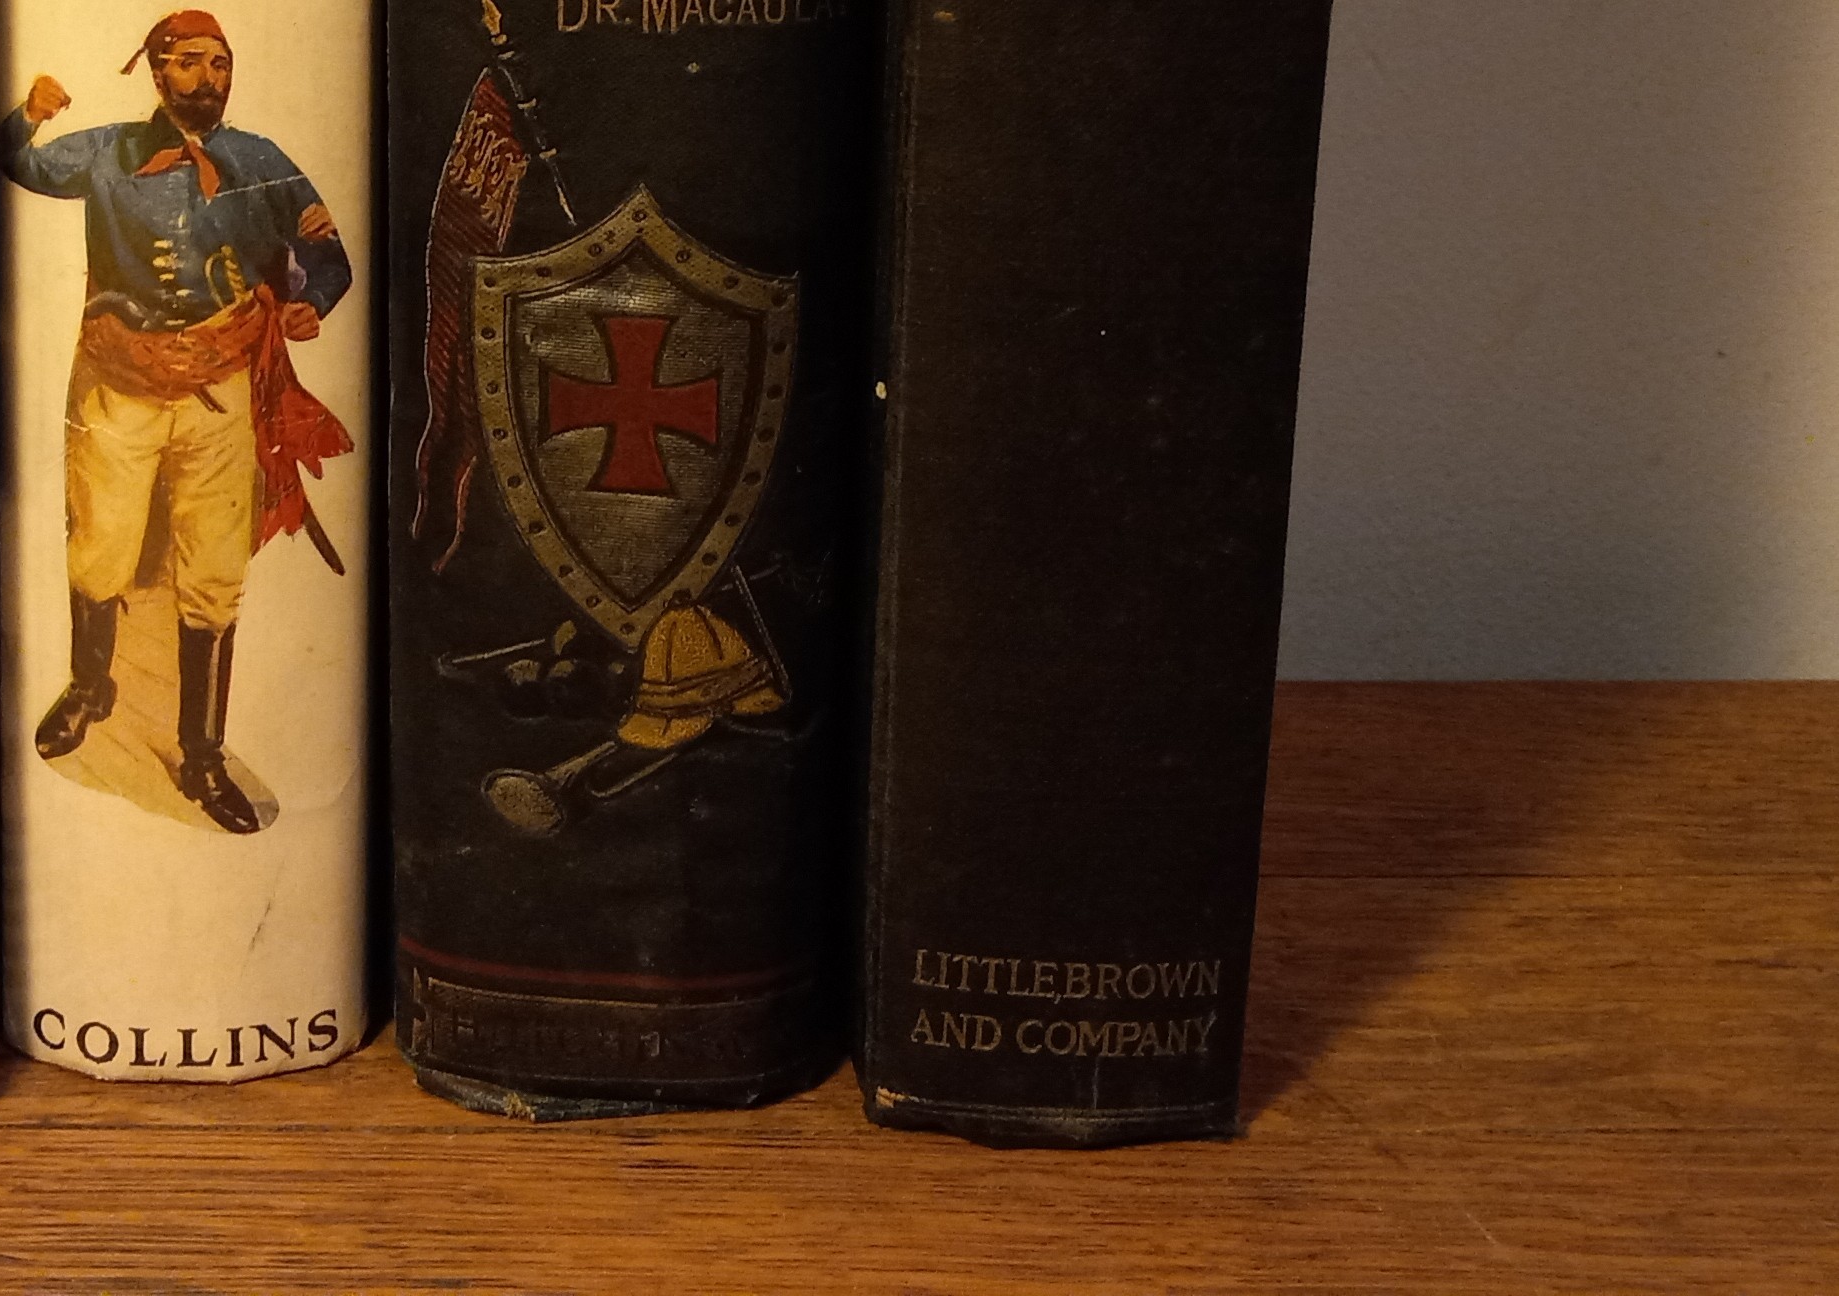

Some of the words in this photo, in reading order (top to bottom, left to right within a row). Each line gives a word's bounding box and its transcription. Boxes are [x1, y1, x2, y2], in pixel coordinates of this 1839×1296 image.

[33, 1007, 338, 1068] COLLINS
[910, 1008, 1002, 1051] AND
[1015, 1010, 1218, 1058] COMPANY
